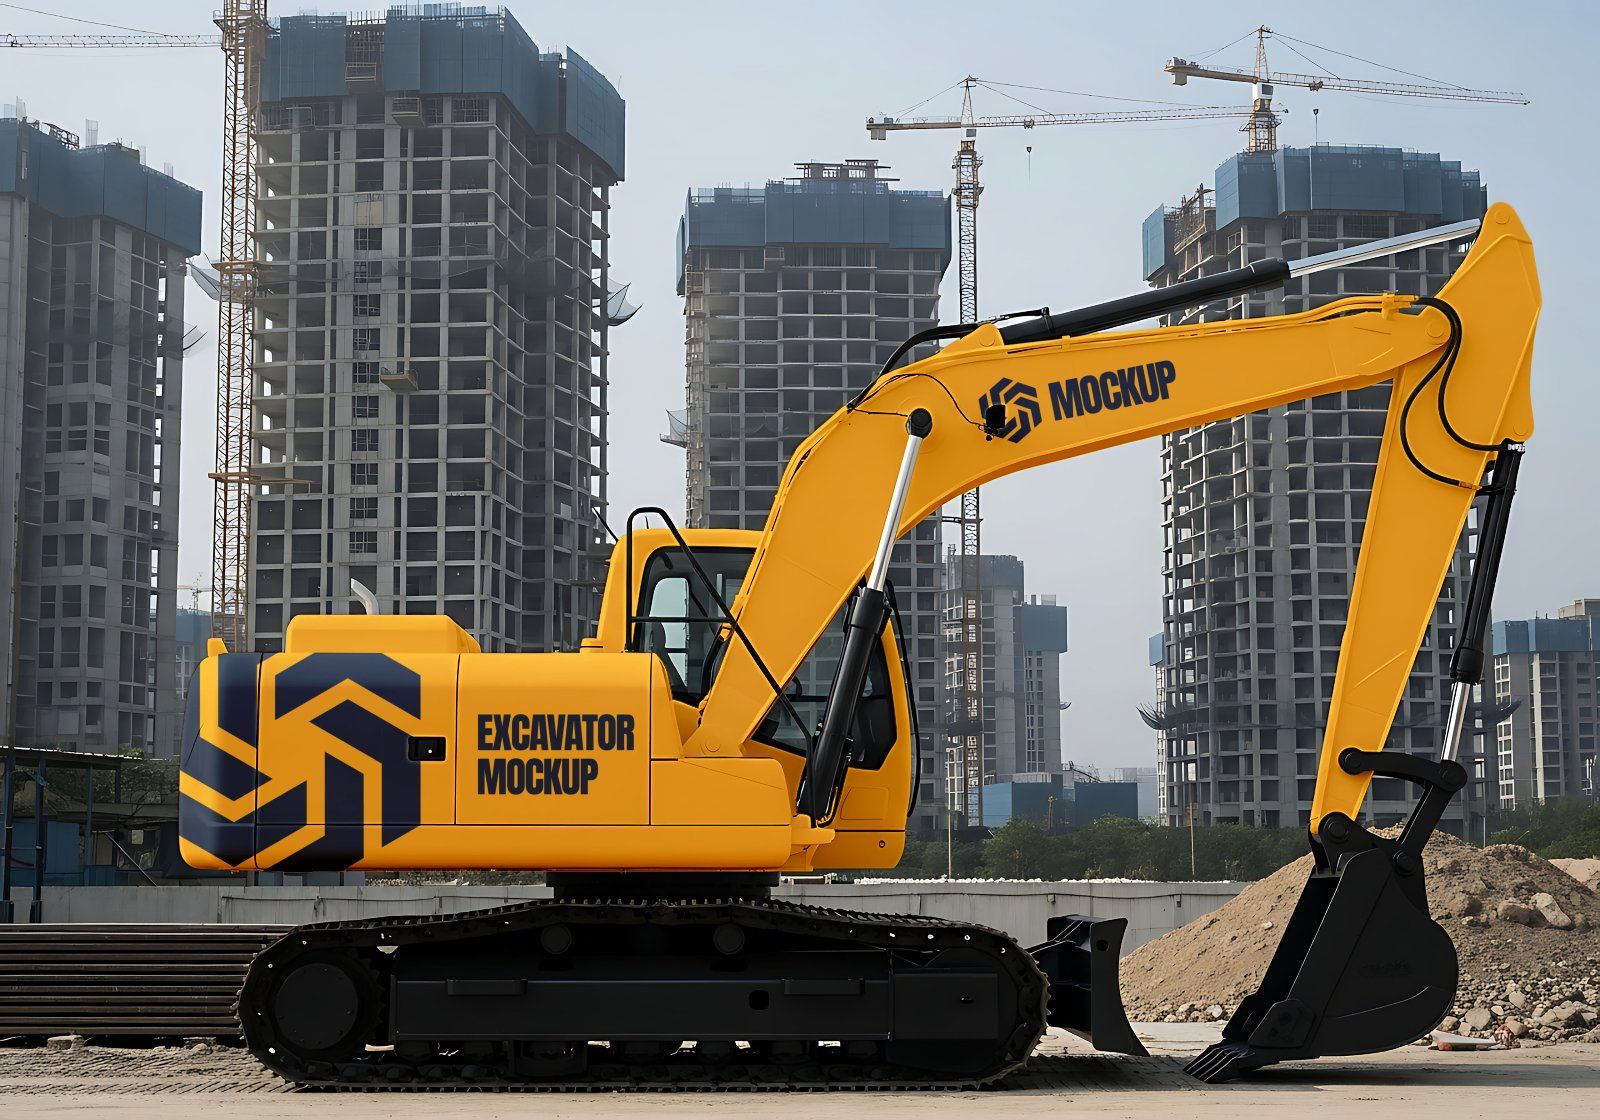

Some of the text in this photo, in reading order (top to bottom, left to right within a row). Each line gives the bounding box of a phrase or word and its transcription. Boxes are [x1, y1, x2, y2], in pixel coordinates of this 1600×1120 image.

[1048, 360, 1176, 420] MOCKUP
[478, 714, 635, 751] EXCAVATOR
[478, 758, 599, 795] MOCKUP
